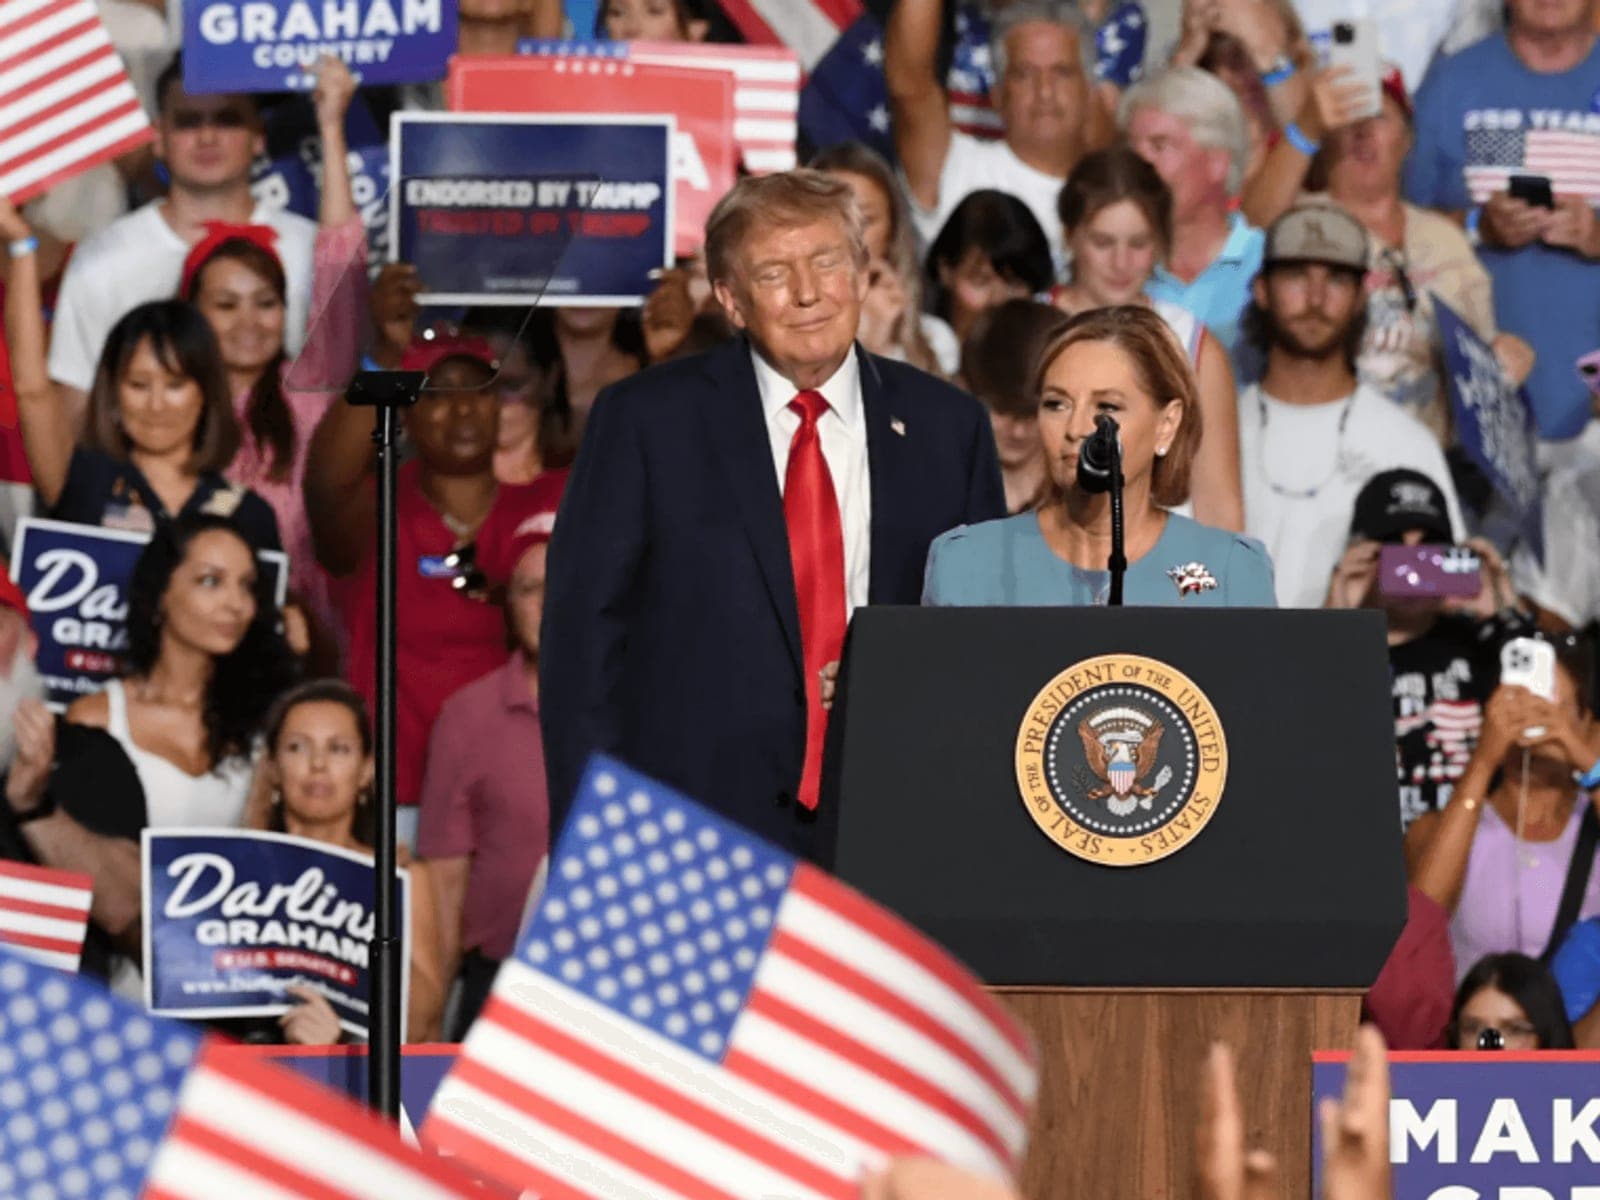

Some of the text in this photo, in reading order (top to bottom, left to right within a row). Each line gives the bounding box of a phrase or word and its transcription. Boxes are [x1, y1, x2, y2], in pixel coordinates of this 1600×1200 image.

[200, 0, 442, 45] GRAHAM
[405, 178, 661, 210] ENDORSED BY TRUMP
[1024, 662, 1220, 856] SEAL OF THE PRESIDENT OF THE UNITED STATES
[195, 918, 369, 970] GRAHAM
